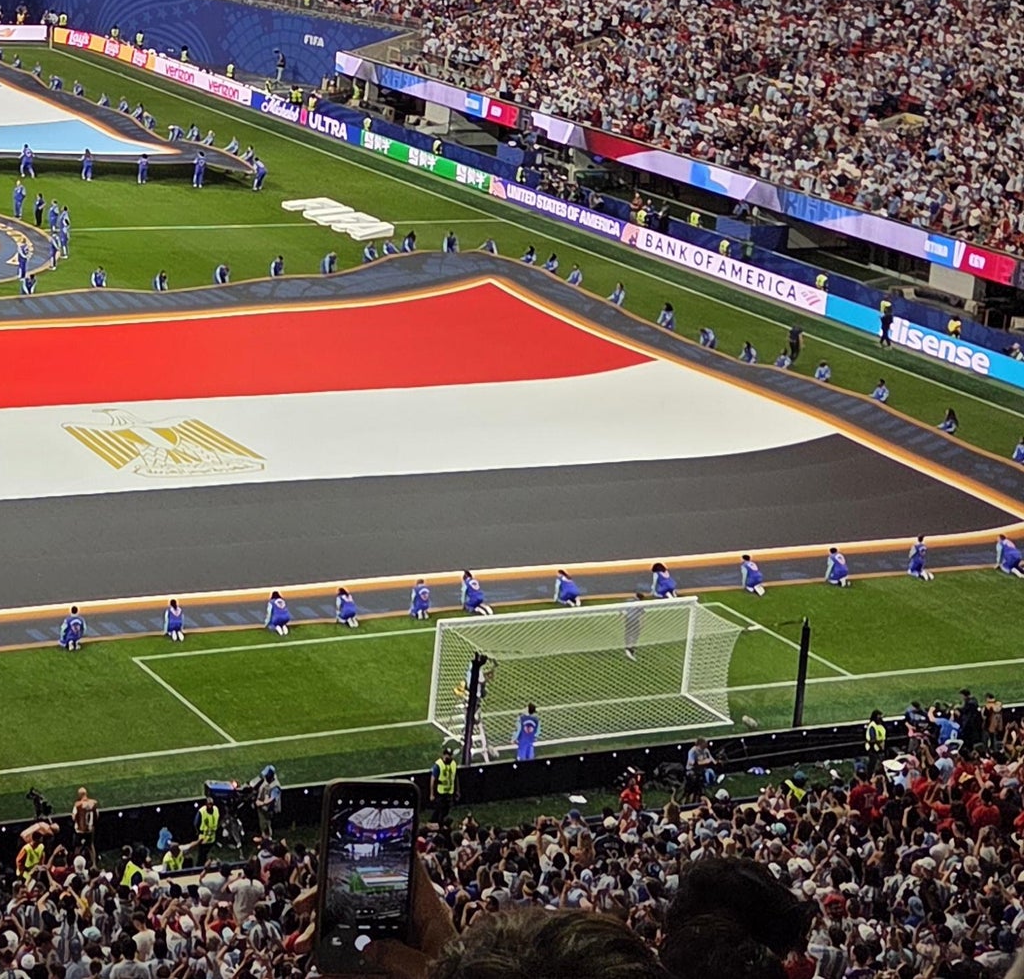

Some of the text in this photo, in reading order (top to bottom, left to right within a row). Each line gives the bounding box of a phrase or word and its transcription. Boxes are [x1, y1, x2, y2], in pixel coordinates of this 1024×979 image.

[304, 34, 324, 48] FIFA
[165, 64, 195, 84] verizon
[208, 78, 239, 99] verizon
[308, 111, 348, 141] ULTRA
[507, 183, 620, 237] UNITED STATES OF AMERICA
[645, 233, 797, 301] BANK OF AMERICA
